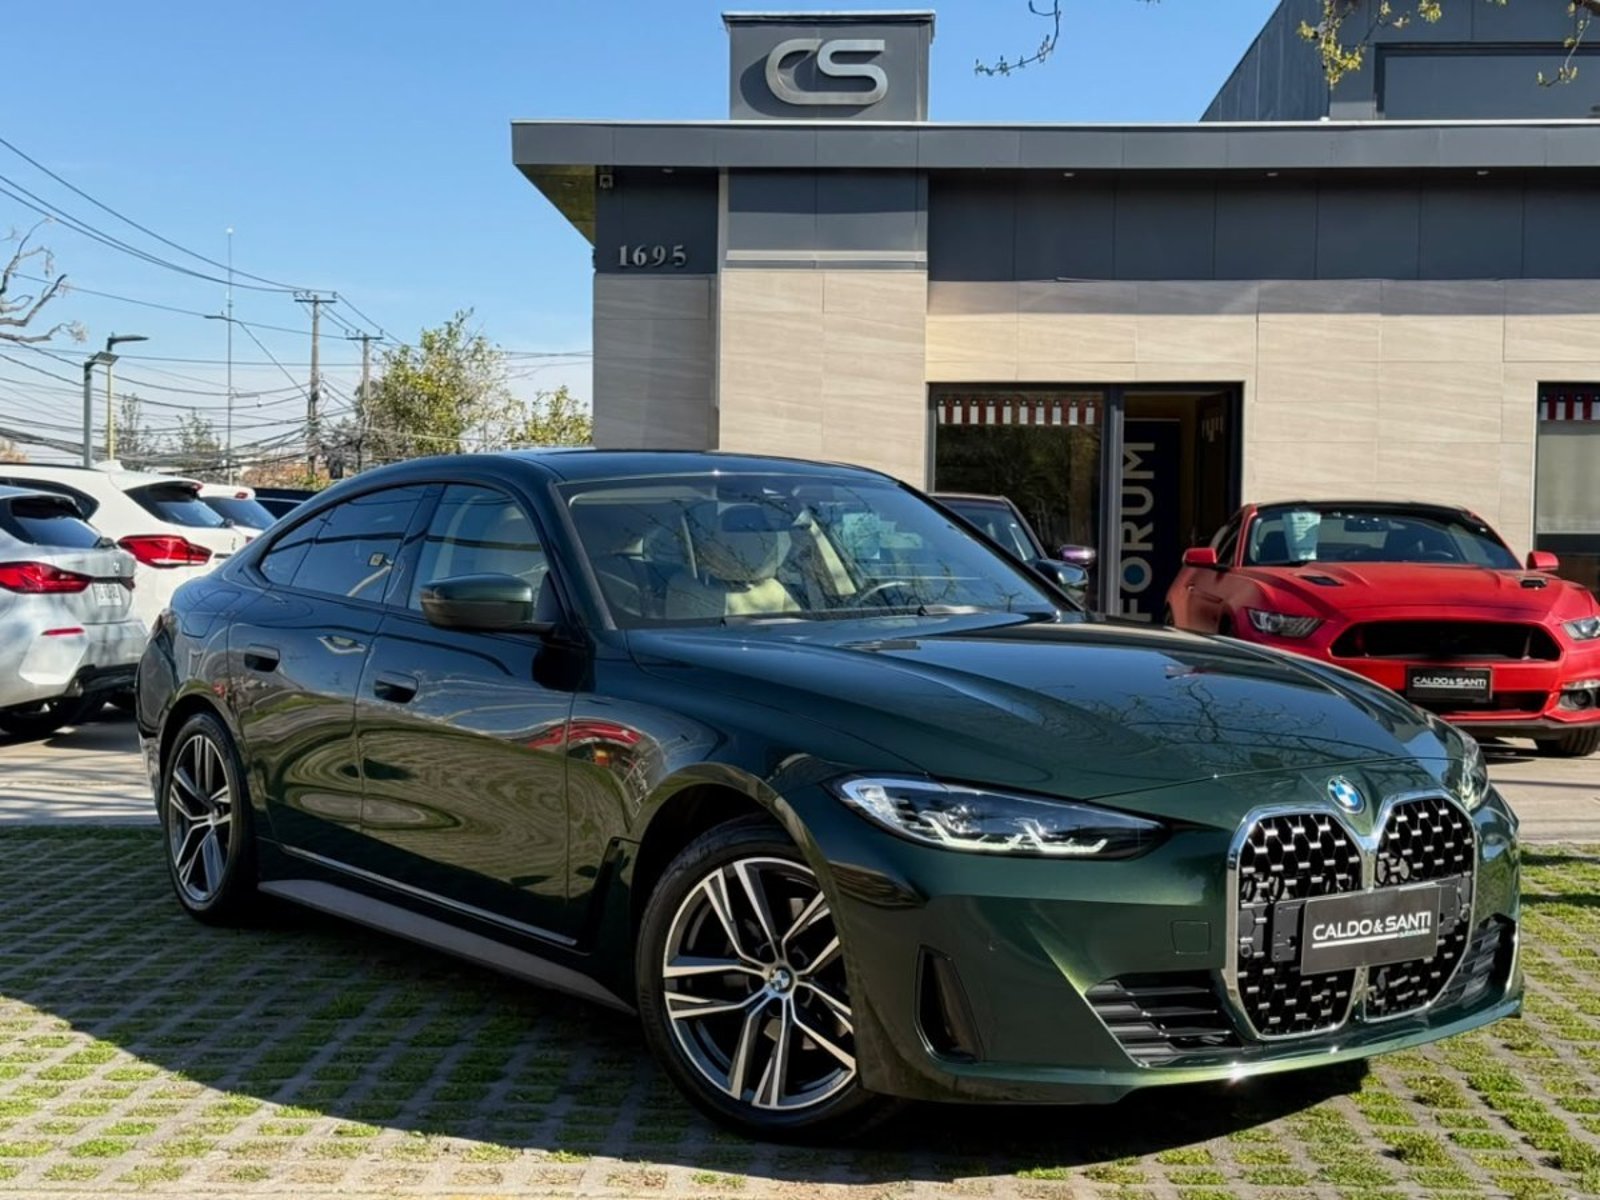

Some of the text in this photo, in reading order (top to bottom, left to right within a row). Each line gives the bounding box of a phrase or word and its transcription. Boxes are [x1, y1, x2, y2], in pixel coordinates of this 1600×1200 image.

[765, 38, 888, 105] CS
[619, 245, 687, 266] 1695
[1120, 443, 1155, 622] FORUM
